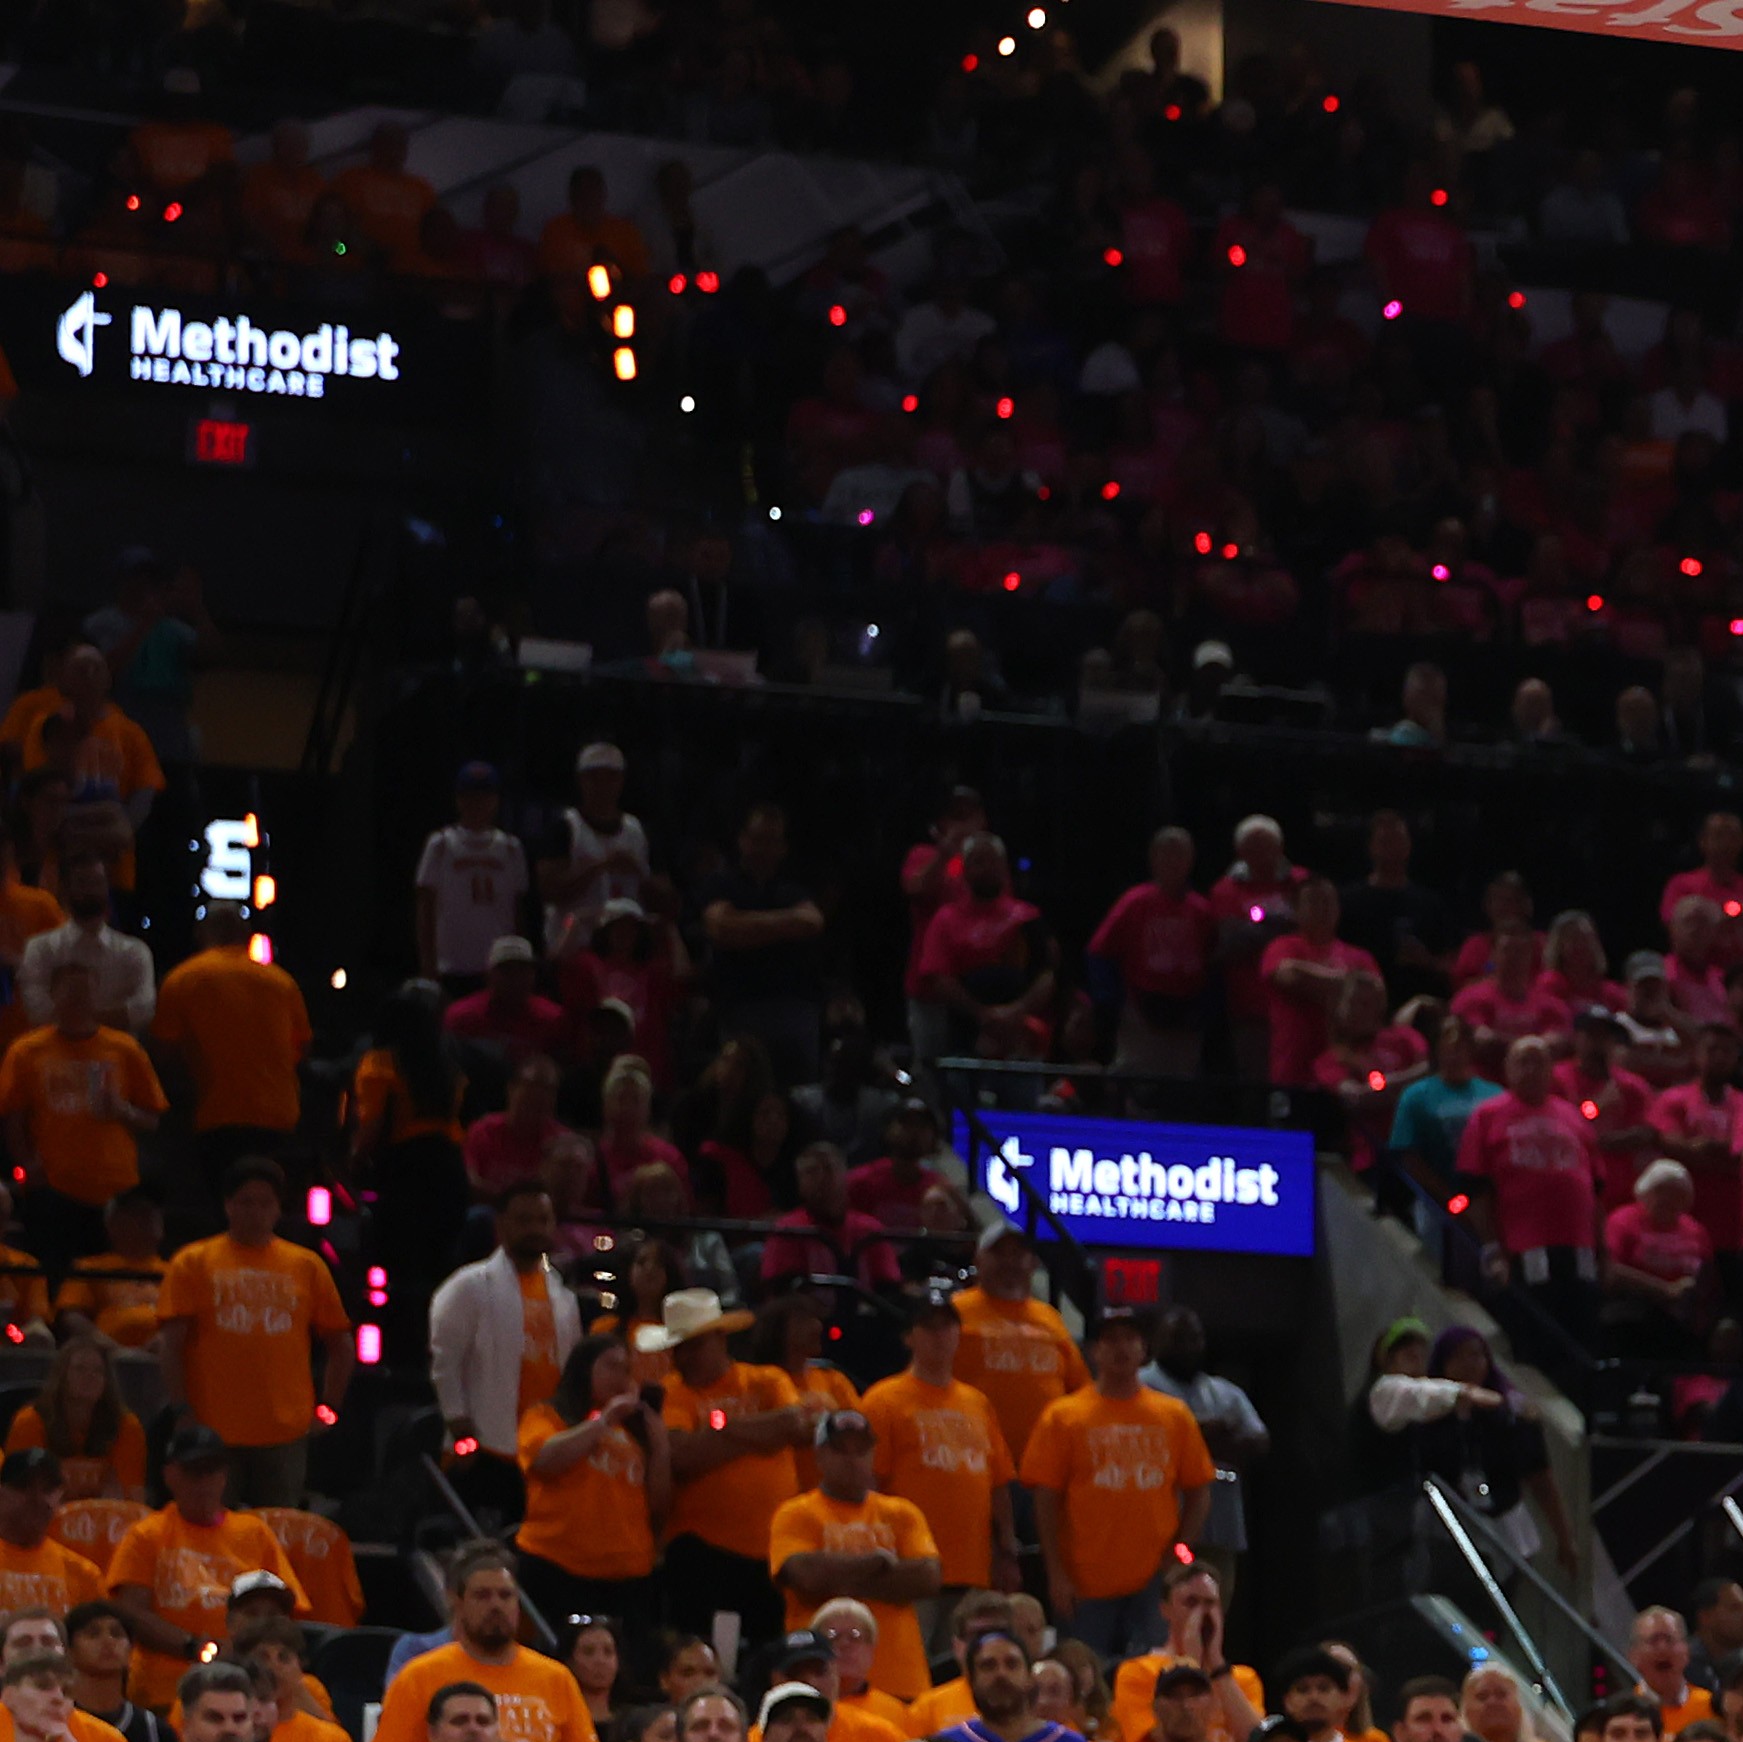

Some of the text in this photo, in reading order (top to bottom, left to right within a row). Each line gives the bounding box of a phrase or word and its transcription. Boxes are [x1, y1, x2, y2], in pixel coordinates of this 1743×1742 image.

[129, 305, 399, 381] Methodist
[129, 356, 325, 399] HEALTHCARE
[196, 418, 249, 464] EXIT
[1049, 1147, 1280, 1206] Methodist
[1049, 1193, 1216, 1223] HEALTHCARE
